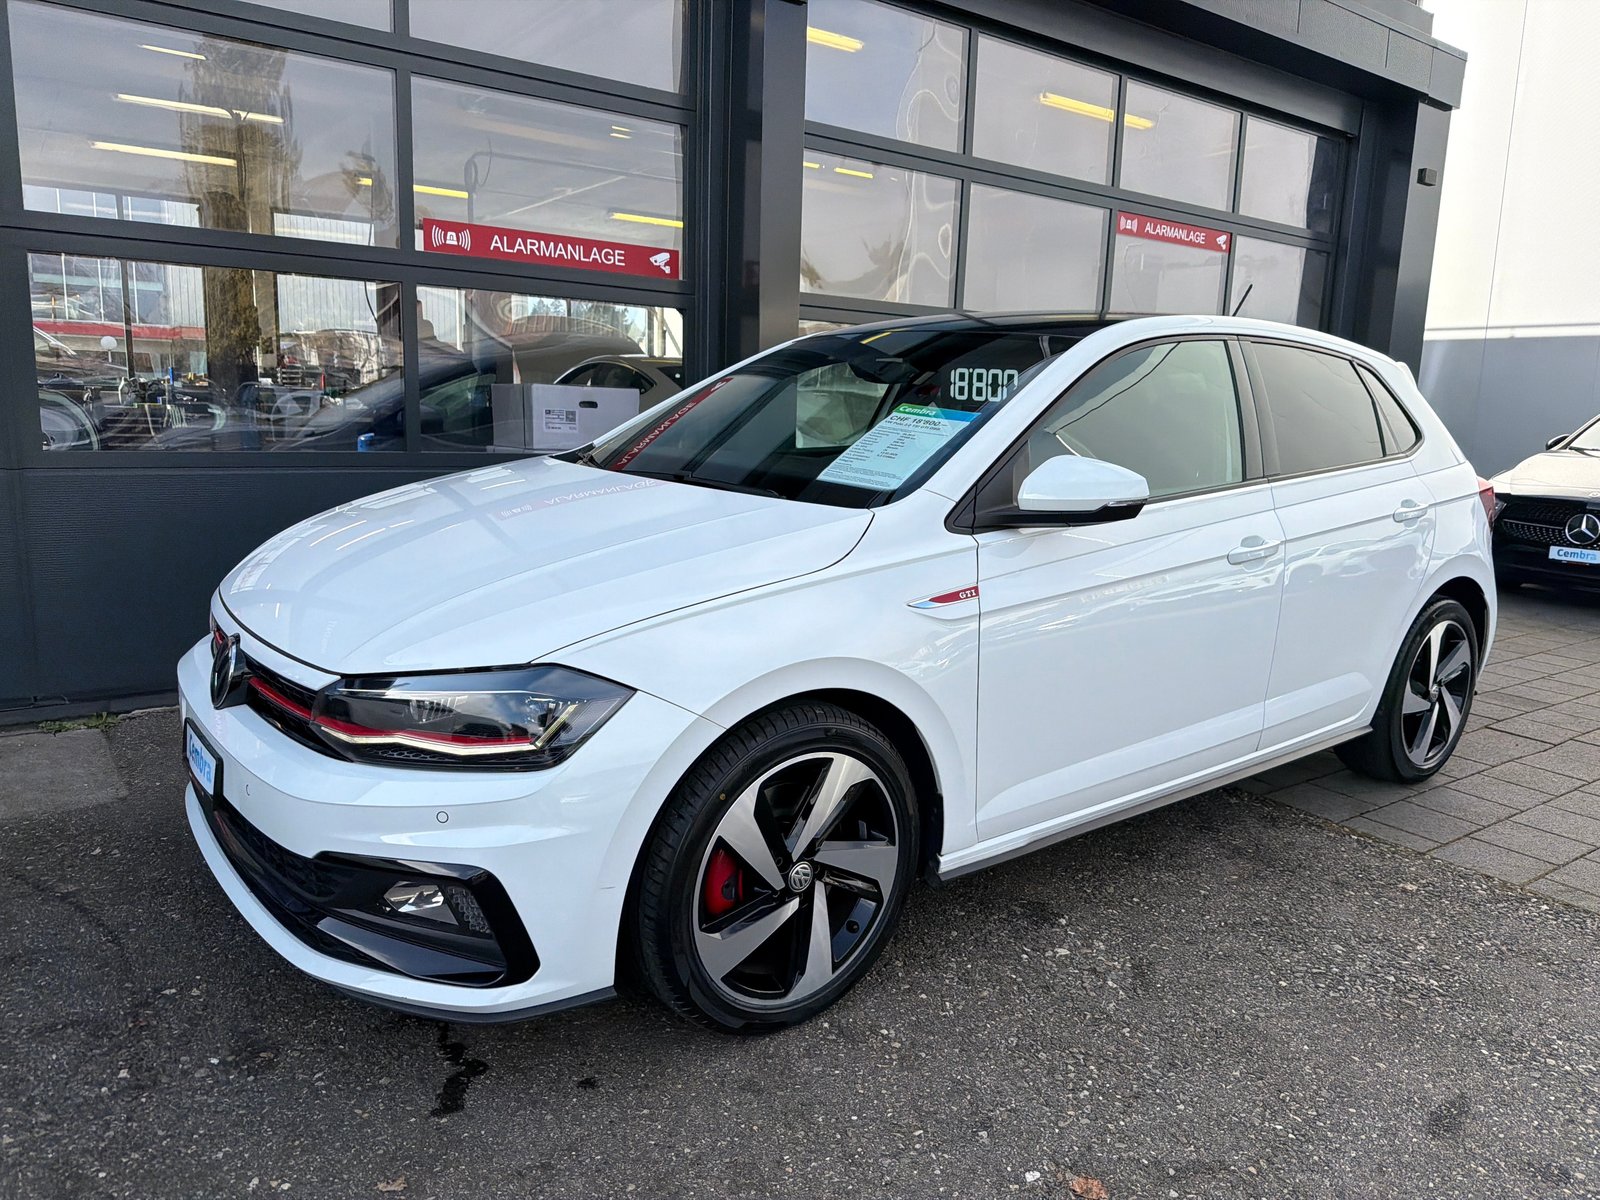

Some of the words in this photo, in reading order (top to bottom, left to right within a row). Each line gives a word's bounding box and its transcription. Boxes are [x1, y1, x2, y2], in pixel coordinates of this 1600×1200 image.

[1144, 222, 1206, 244] ALARMANLAGE
[490, 235, 626, 266] ALARMANLAGE
[900, 405, 937, 416] Cembra
[1557, 549, 1597, 560] Cembra
[959, 589, 977, 599] GTI
[189, 734, 212, 784] Cembra
